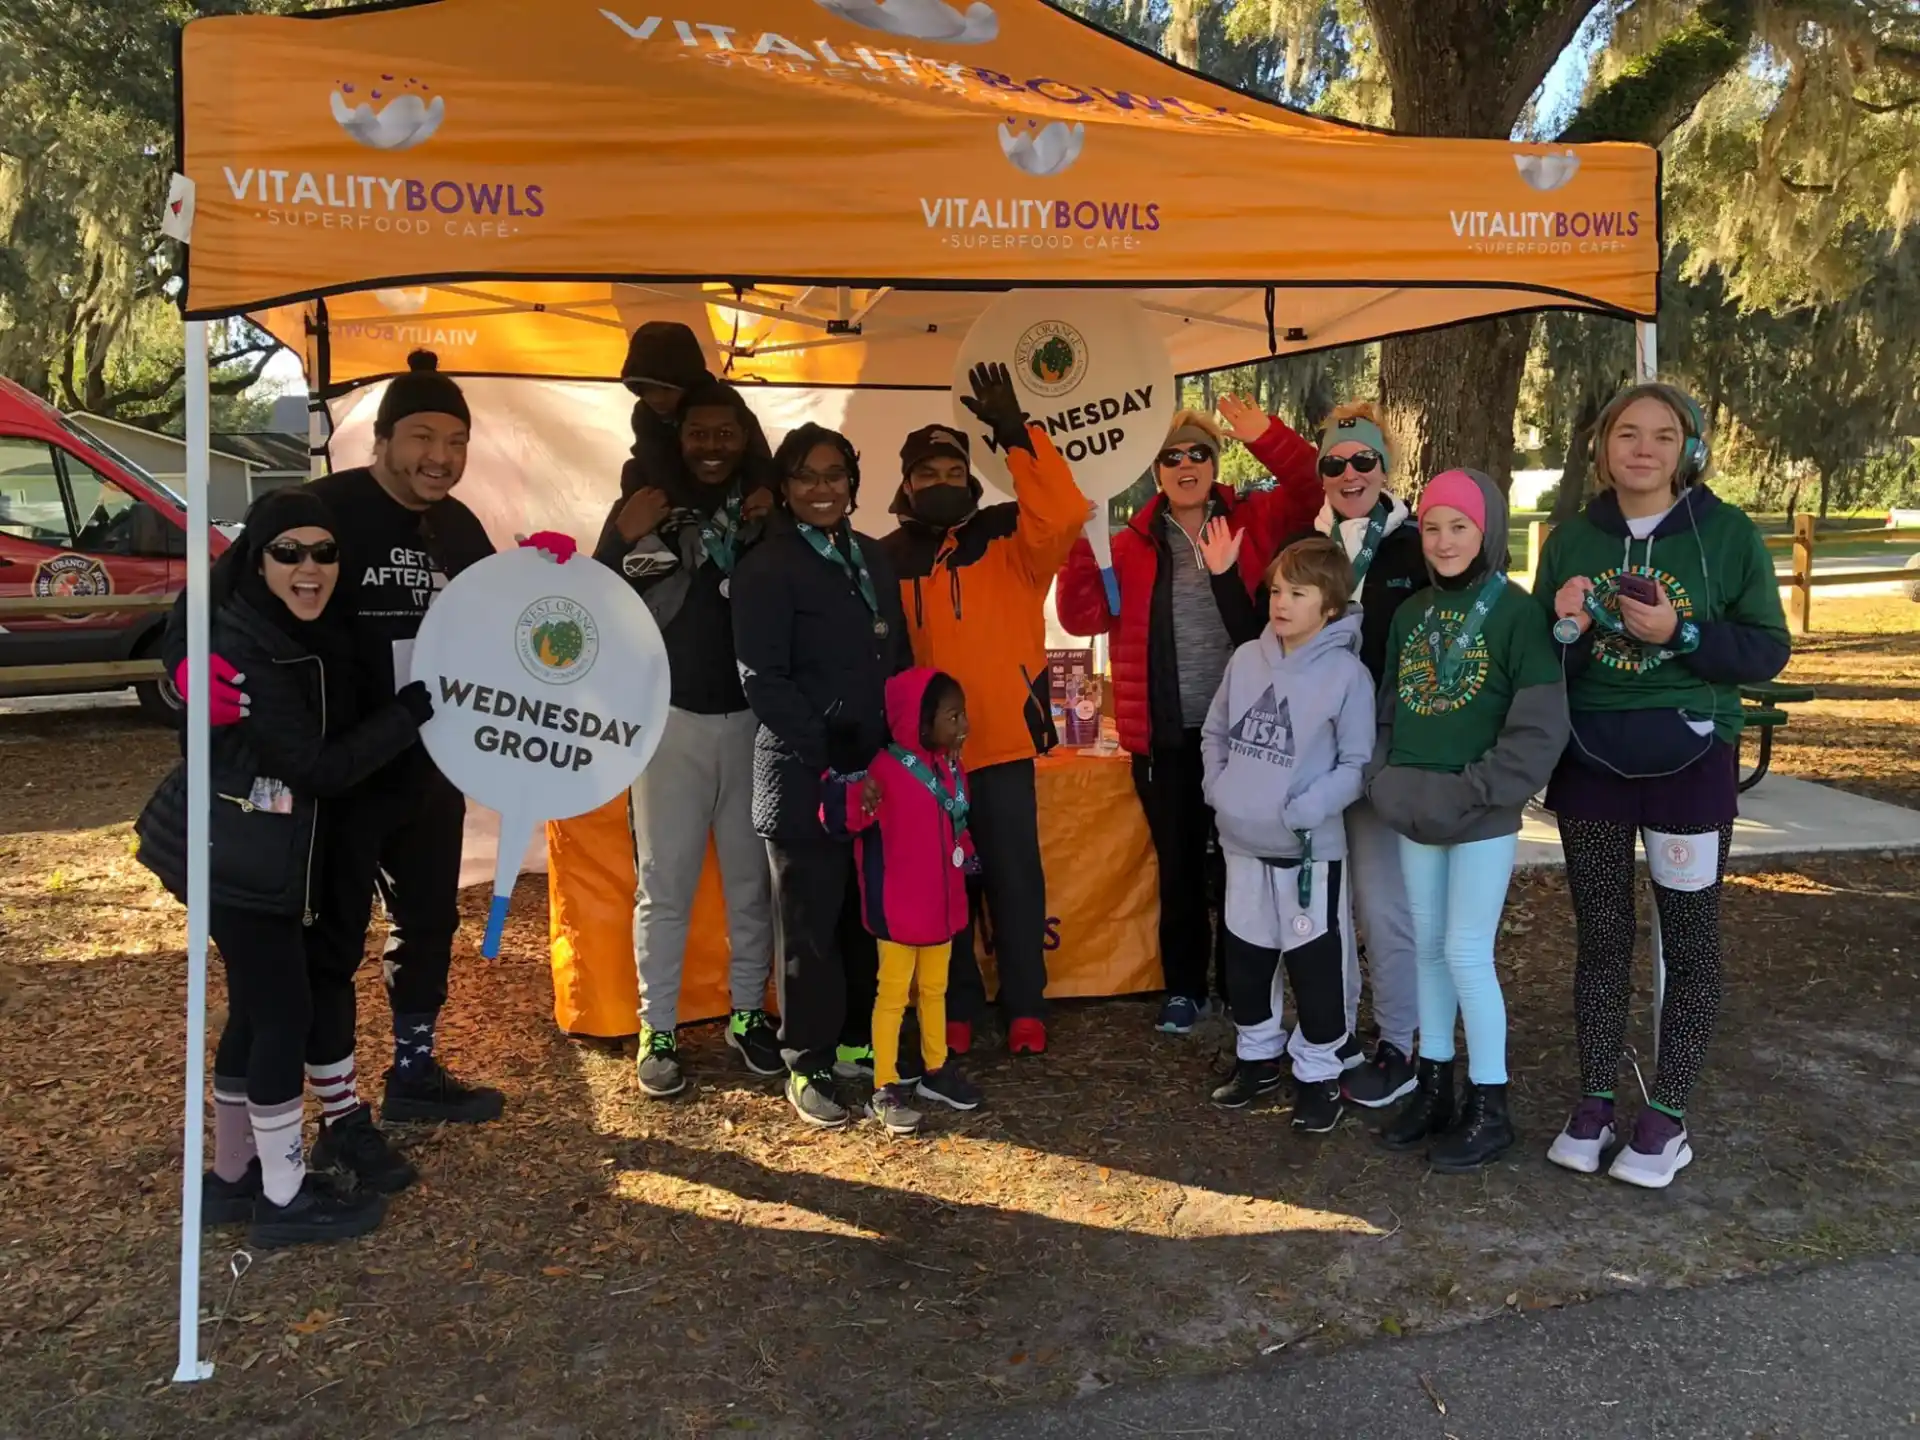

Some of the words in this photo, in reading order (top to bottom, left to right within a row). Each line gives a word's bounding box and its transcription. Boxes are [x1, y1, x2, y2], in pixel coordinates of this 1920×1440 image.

[266, 209, 431, 236] SUPERFOOD
[950, 234, 1074, 251] SUPERFOOD
[1474, 241, 1571, 255] SUPERFOOD
[389, 547, 426, 568] GET
[361, 566, 431, 588] AFTER
[411, 588, 429, 607] IT
[519, 600, 552, 627] WEST
[556, 600, 597, 641] ORANGE
[438, 675, 642, 748] WEDNESDAY
[1241, 716, 1288, 751] USA
[474, 725, 593, 772] GROUP
